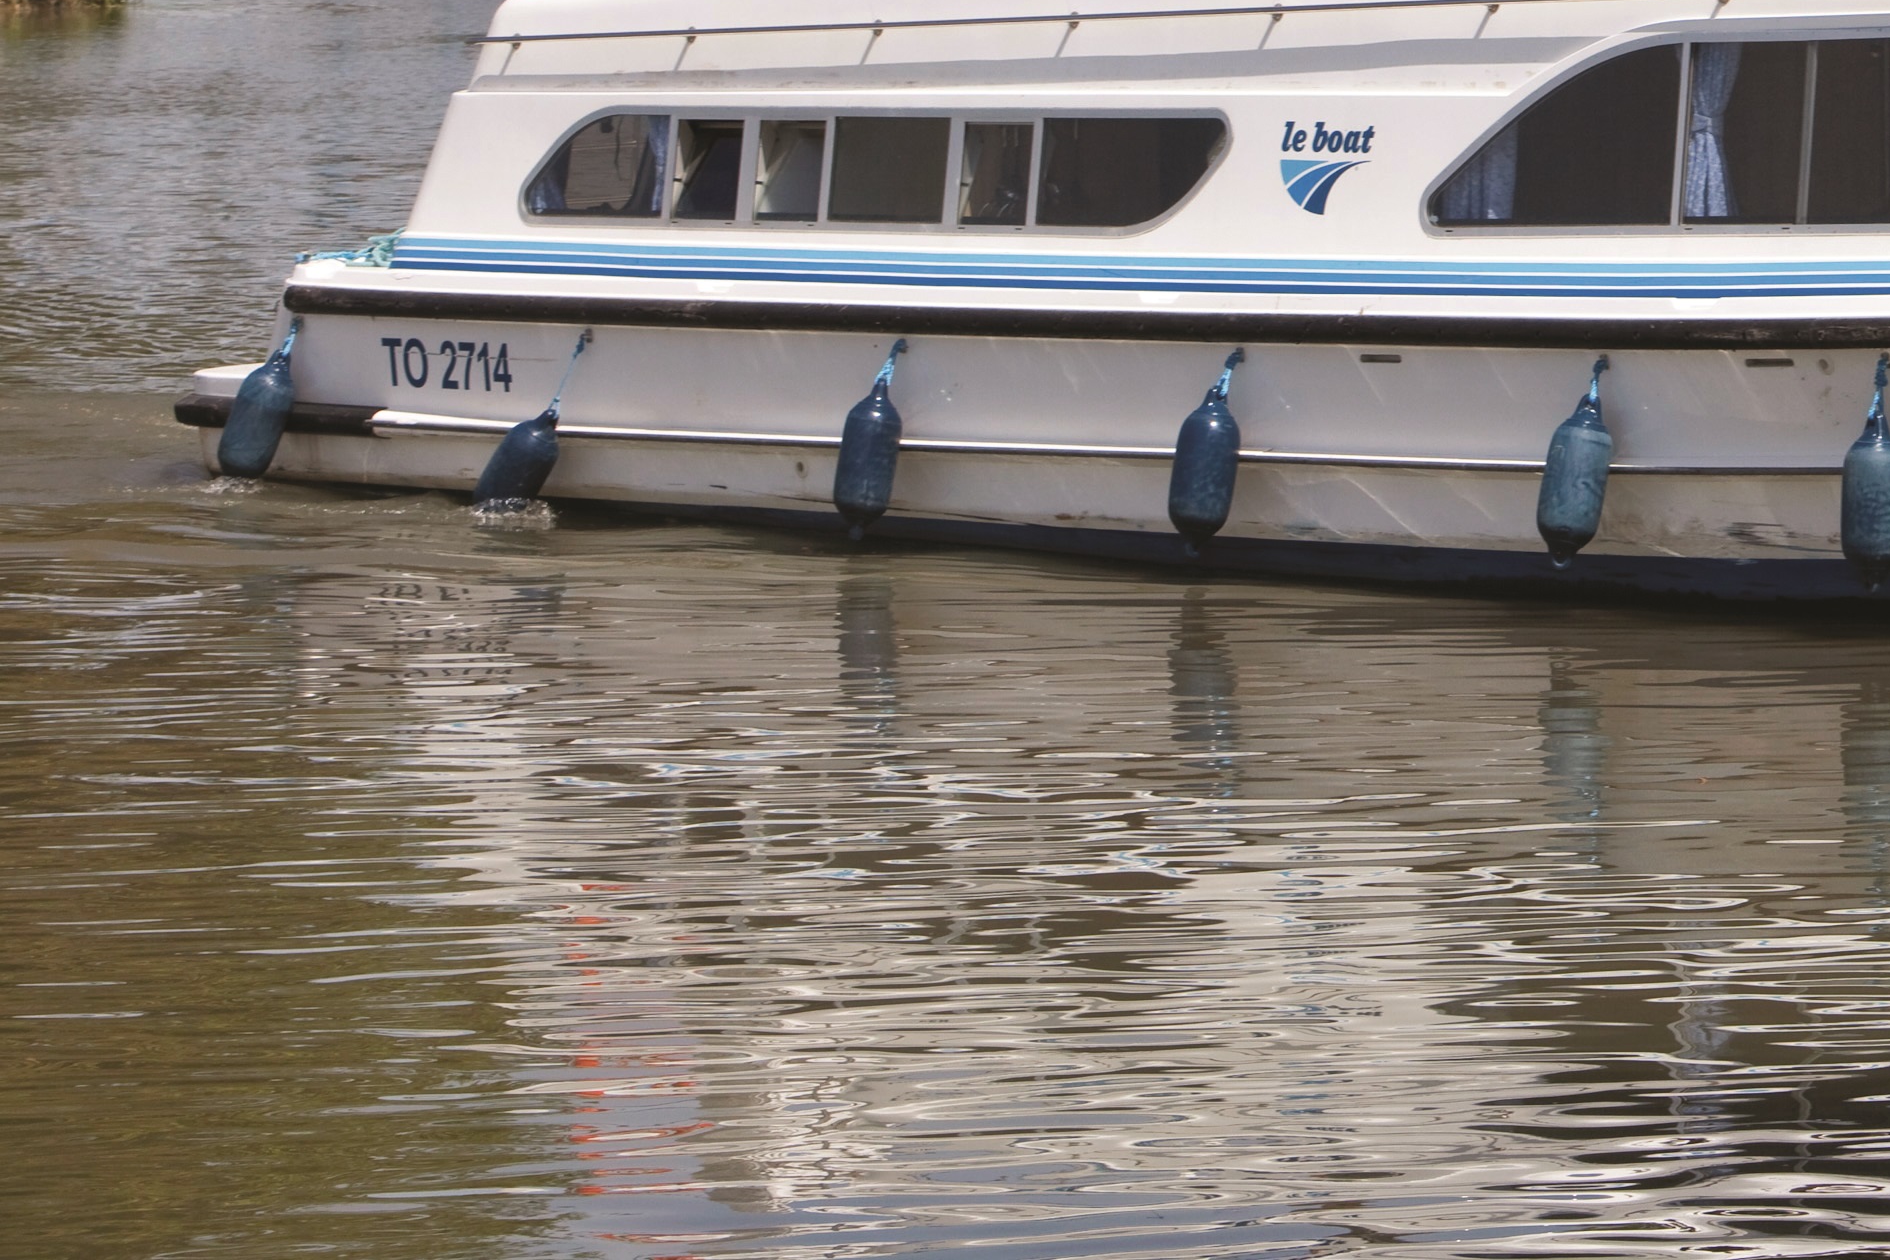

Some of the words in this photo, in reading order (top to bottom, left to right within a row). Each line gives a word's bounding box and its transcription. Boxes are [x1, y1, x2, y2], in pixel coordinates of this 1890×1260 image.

[1281, 121, 1307, 152] le
[1312, 121, 1376, 153] boat
[381, 338, 429, 388] TO
[440, 340, 513, 393] 2714
